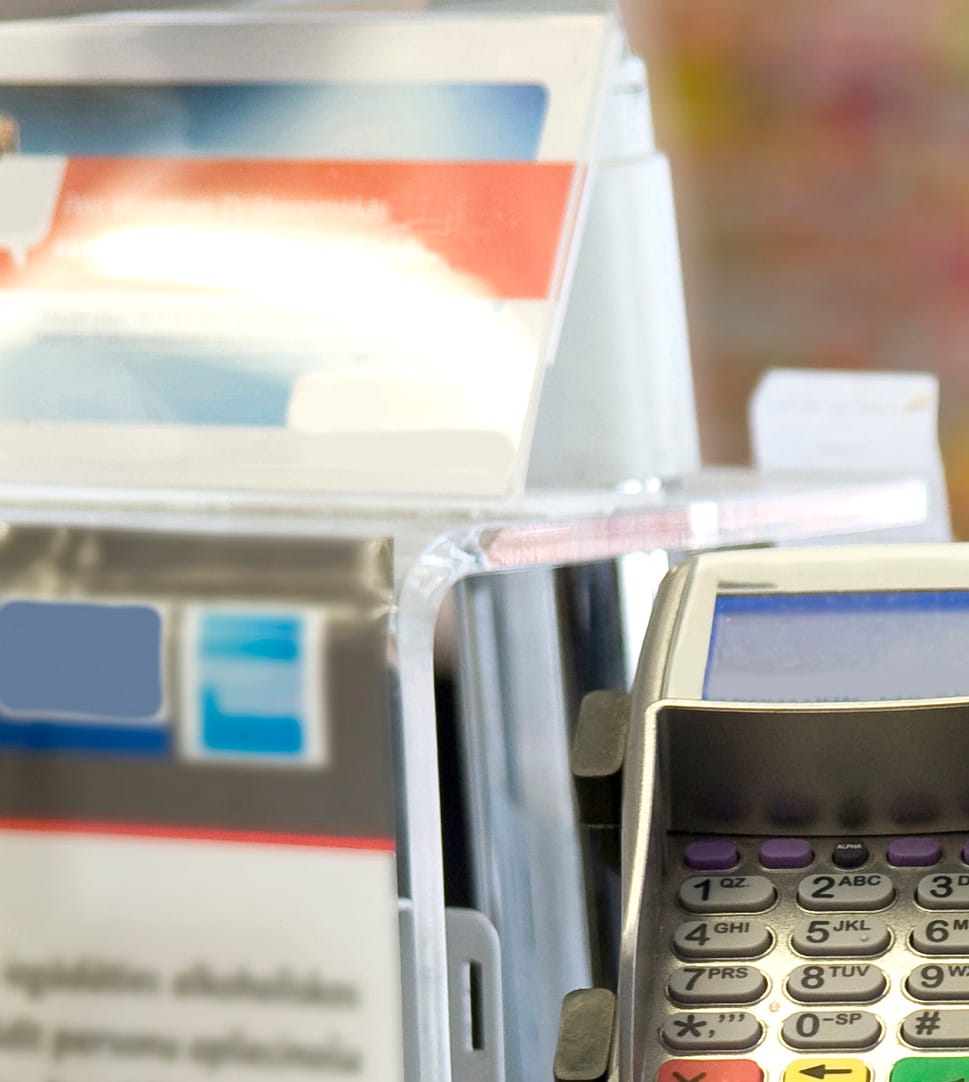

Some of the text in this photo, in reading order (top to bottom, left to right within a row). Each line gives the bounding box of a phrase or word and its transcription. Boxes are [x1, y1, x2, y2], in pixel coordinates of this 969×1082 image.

[694, 879, 711, 901] 1
[811, 875, 881, 898] 2 ABC
[930, 875, 953, 898] 3
[685, 922, 750, 946] 4 GHI
[806, 919, 871, 943] 5 JKL
[925, 919, 949, 942] 6
[683, 967, 749, 991] 7 PRS
[801, 965, 870, 989] 8 TUV
[920, 965, 944, 988] 9
